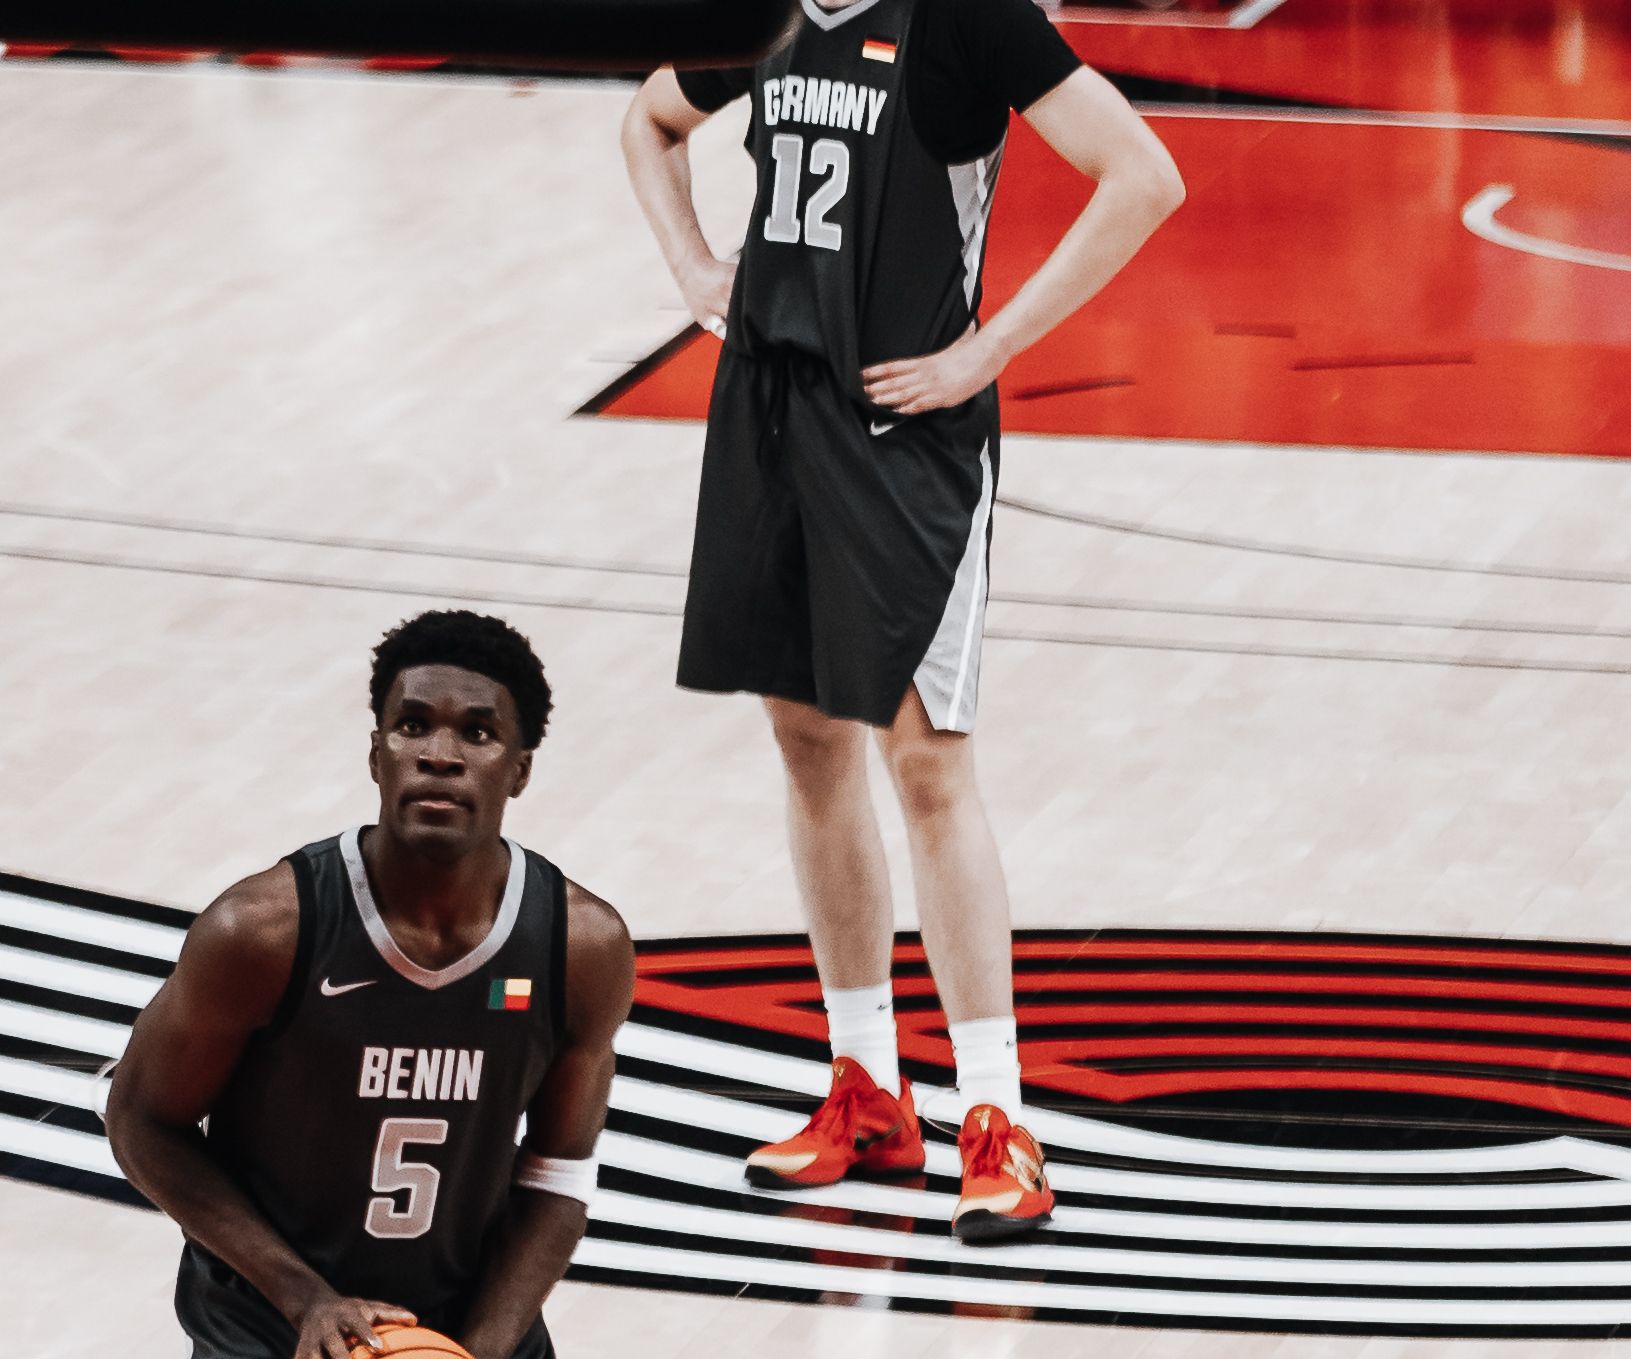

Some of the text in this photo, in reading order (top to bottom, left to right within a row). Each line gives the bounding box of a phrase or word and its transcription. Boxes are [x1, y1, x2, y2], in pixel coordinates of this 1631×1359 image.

[764, 74, 887, 135] GRMANY
[764, 133, 850, 251] 12
[358, 1046, 484, 1100] BENIN
[365, 1117, 449, 1239] 5
